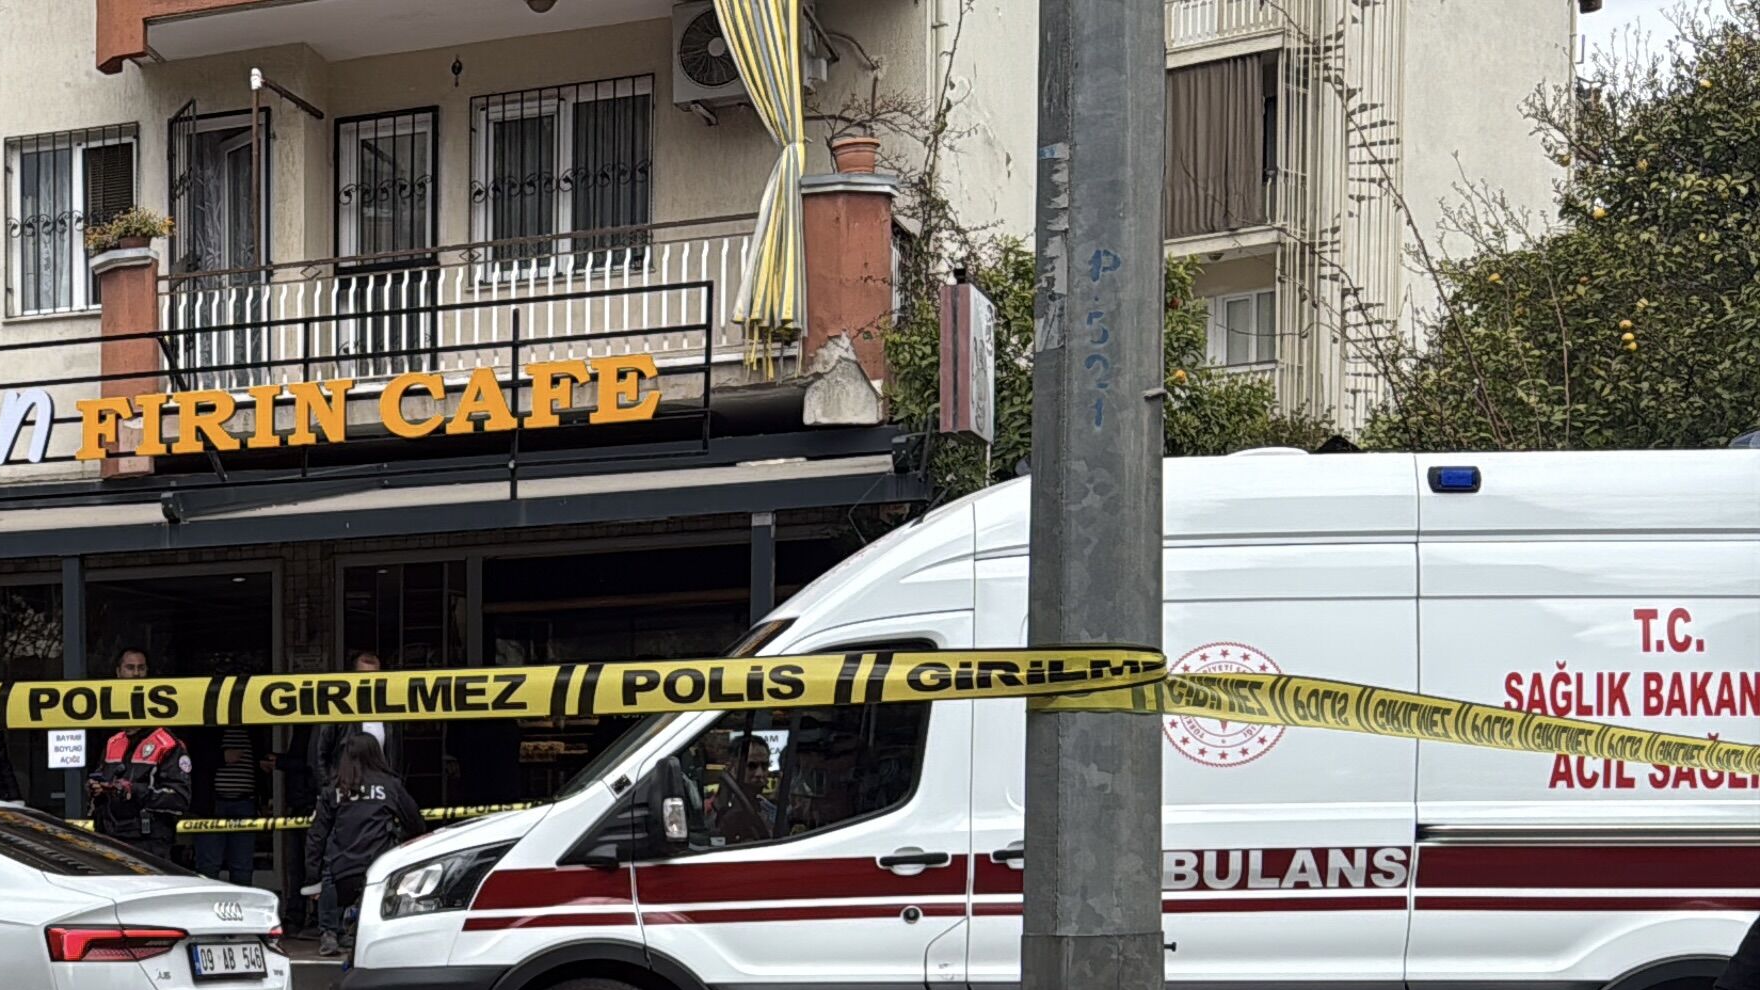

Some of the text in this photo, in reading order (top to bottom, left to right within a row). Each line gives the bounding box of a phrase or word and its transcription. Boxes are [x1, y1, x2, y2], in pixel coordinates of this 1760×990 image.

[76, 379, 354, 461] FIRIN
[380, 354, 663, 440] CAFE
[1633, 607, 1705, 652] T.C.
[28, 684, 179, 722] POLİS
[259, 674, 528, 717] GİRİLMEZ
[622, 664, 806, 706] POLİS
[906, 659, 1165, 692] GİRİLM
[1504, 660, 1760, 717] SAĞLIK BAKAN
[1161, 848, 1409, 889] BULANS
[200, 948, 215, 971] 09
[222, 947, 236, 970] AB
